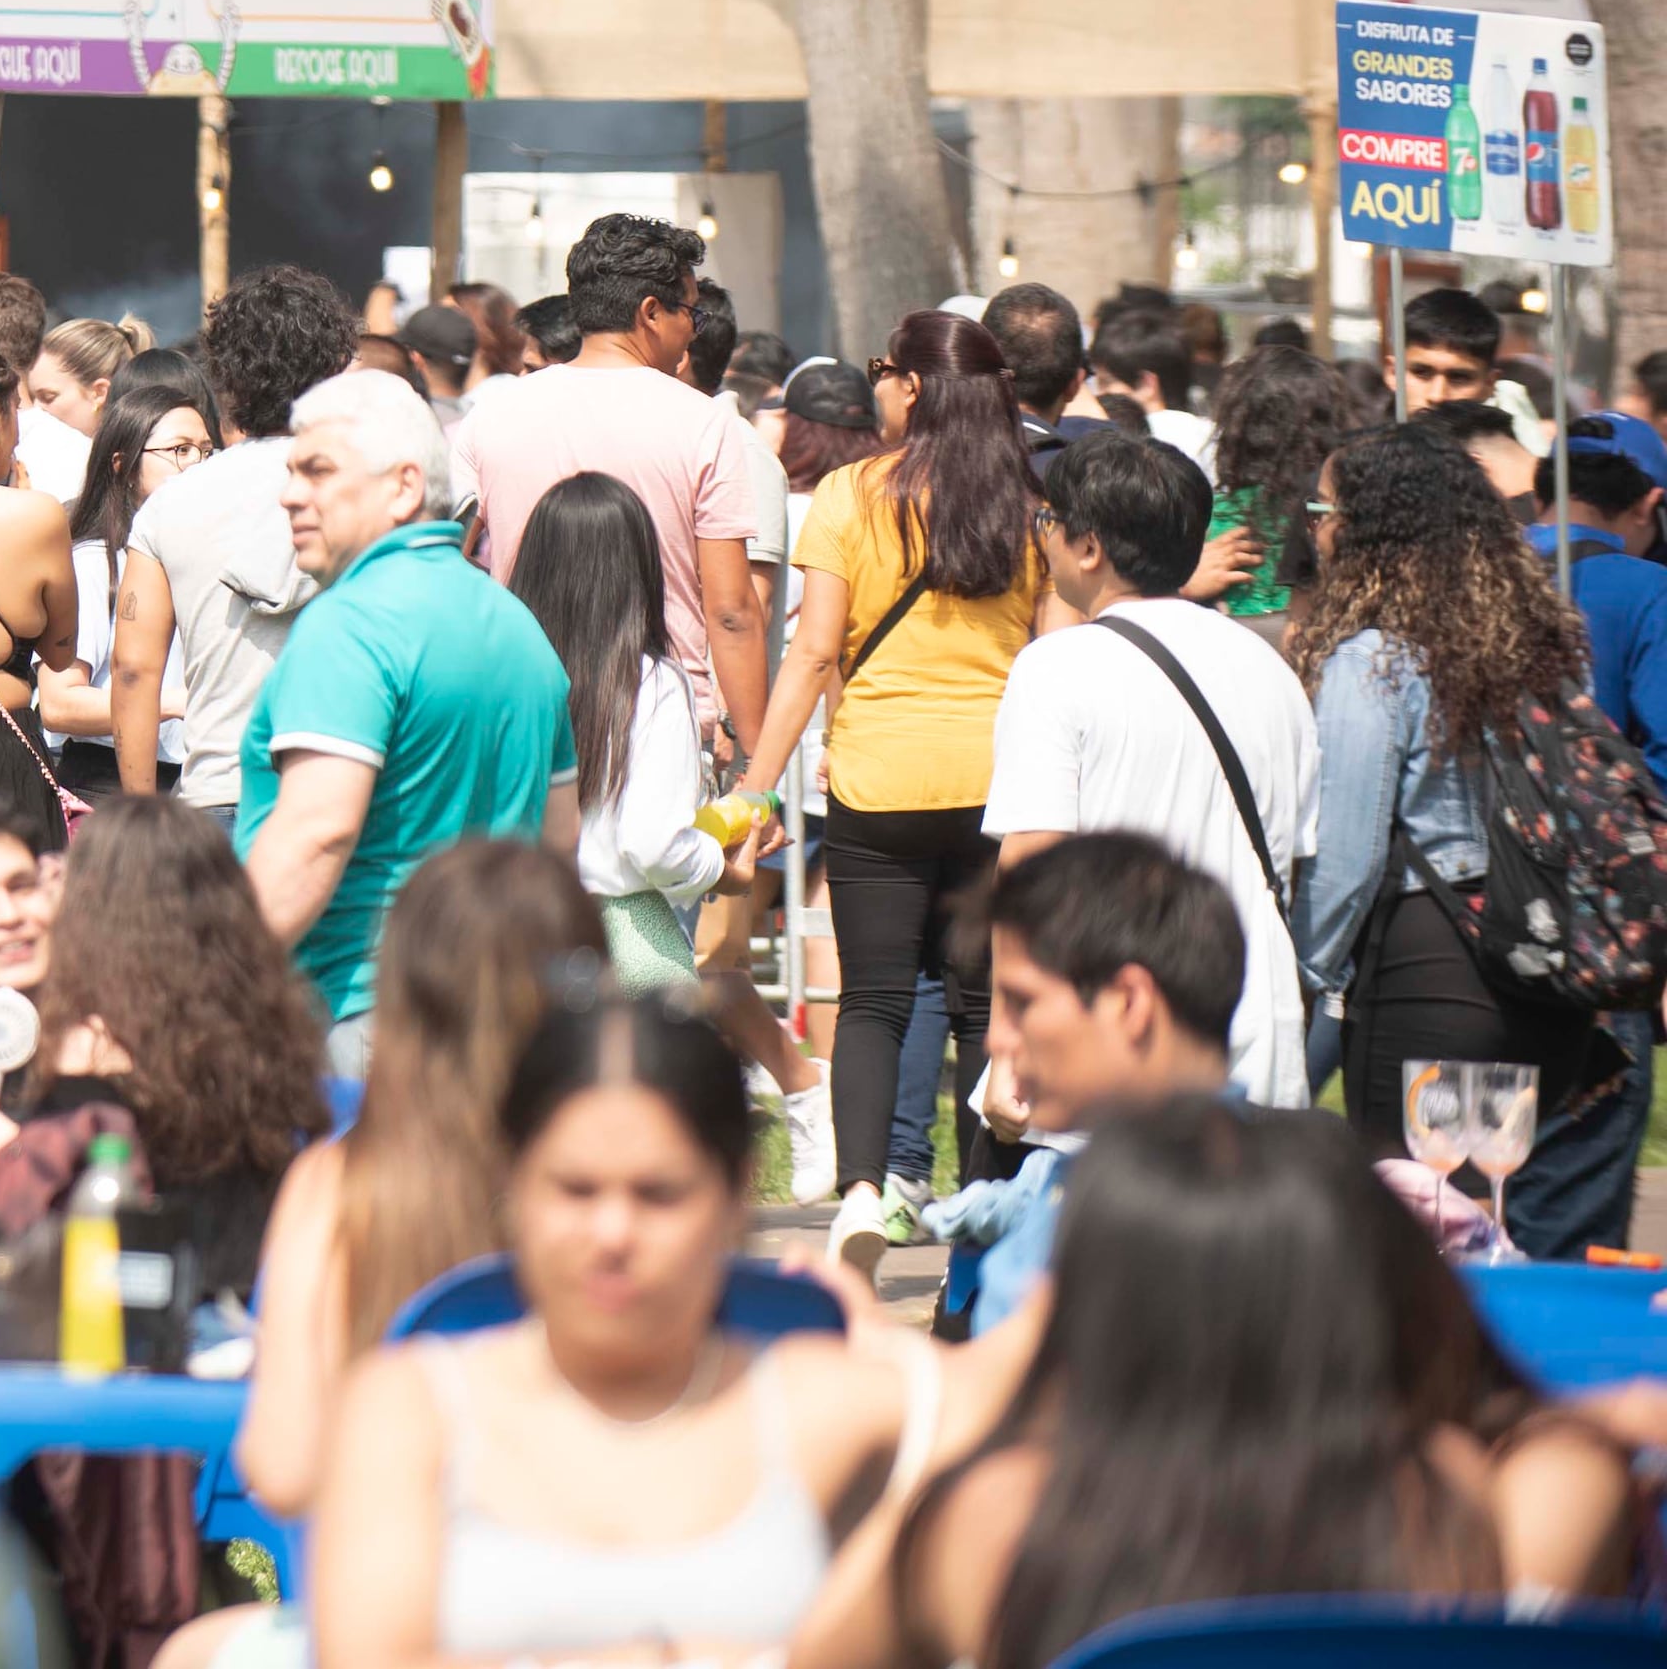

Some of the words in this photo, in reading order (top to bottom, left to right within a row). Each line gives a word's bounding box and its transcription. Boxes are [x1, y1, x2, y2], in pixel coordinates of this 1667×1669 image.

[1356, 21, 1430, 44] DISFRUTA
[1432, 27, 1455, 47] DE
[35, 40, 81, 85] AQUÍ
[275, 47, 343, 84] RECOGE
[1352, 49, 1454, 81] GRANDES
[1355, 77, 1452, 109] SABORES
[1341, 133, 1443, 168] COMPRE
[1350, 178, 1442, 229] AQUÍ
